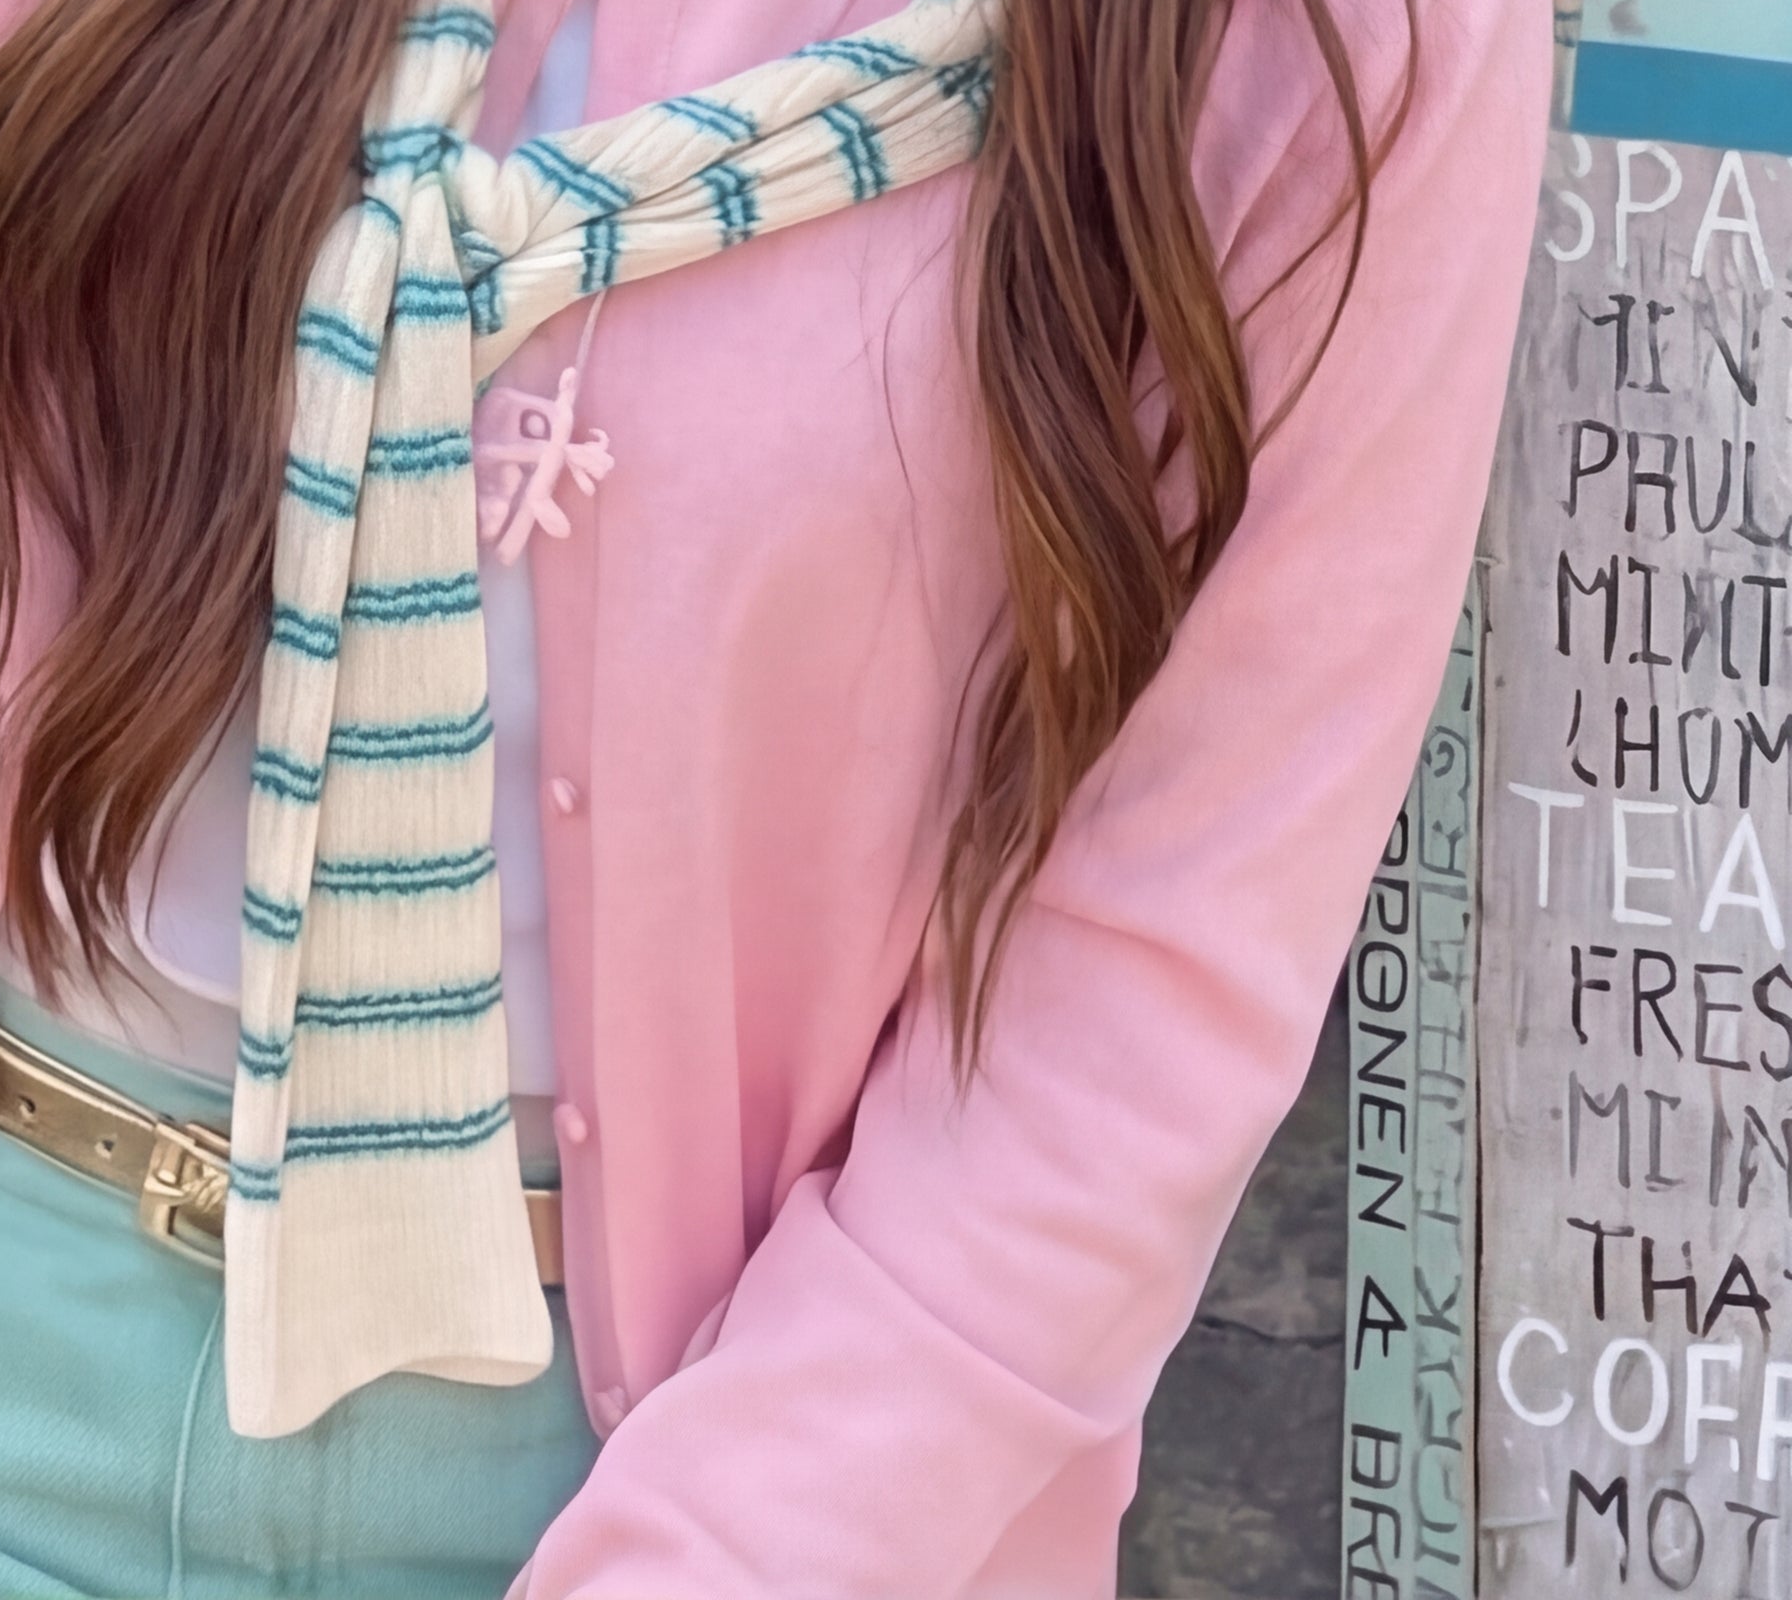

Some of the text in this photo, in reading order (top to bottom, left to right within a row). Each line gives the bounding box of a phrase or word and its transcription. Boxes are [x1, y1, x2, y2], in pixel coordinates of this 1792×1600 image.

[1545, 134, 1792, 289] SPA
[1508, 781, 1785, 950] TEA
[1566, 1217, 1792, 1352] THA
